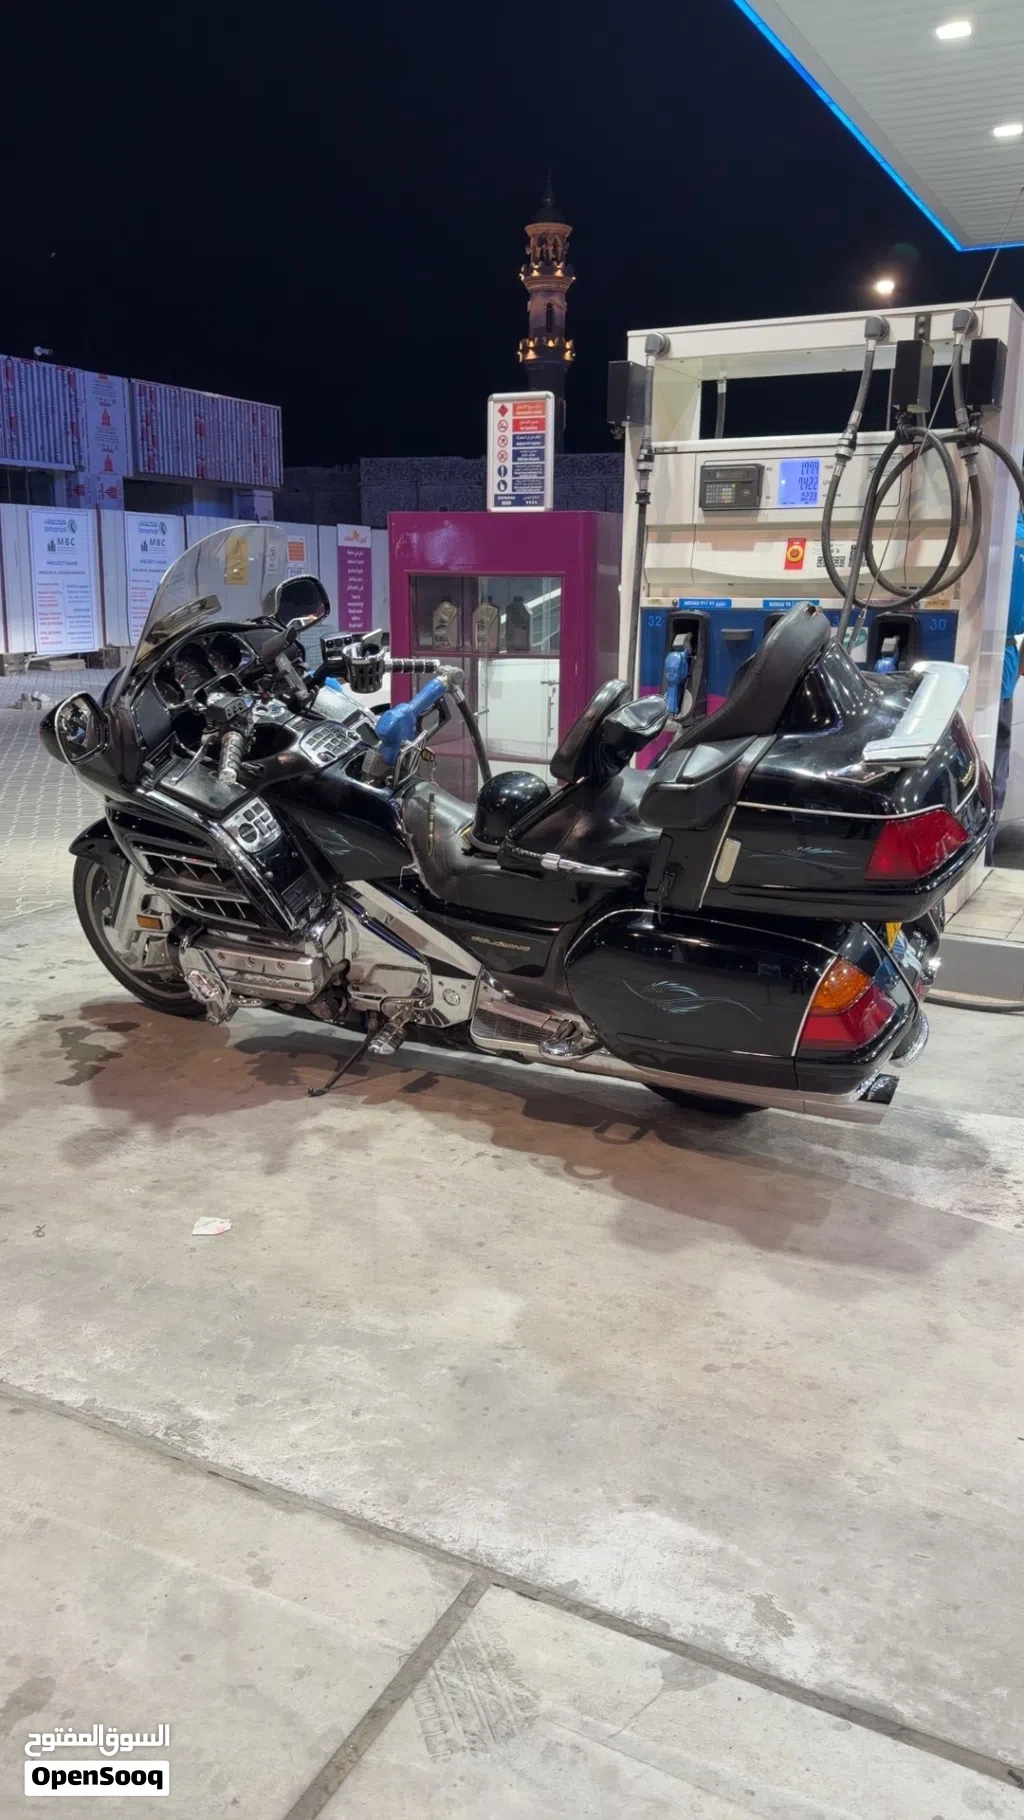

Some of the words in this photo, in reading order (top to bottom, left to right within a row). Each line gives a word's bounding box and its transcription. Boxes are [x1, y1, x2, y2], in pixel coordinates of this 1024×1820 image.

[57, 537, 75, 546] MBC
[149, 538, 166, 546] MBC
[648, 616, 662, 627] 32
[930, 618, 946, 631] 30
